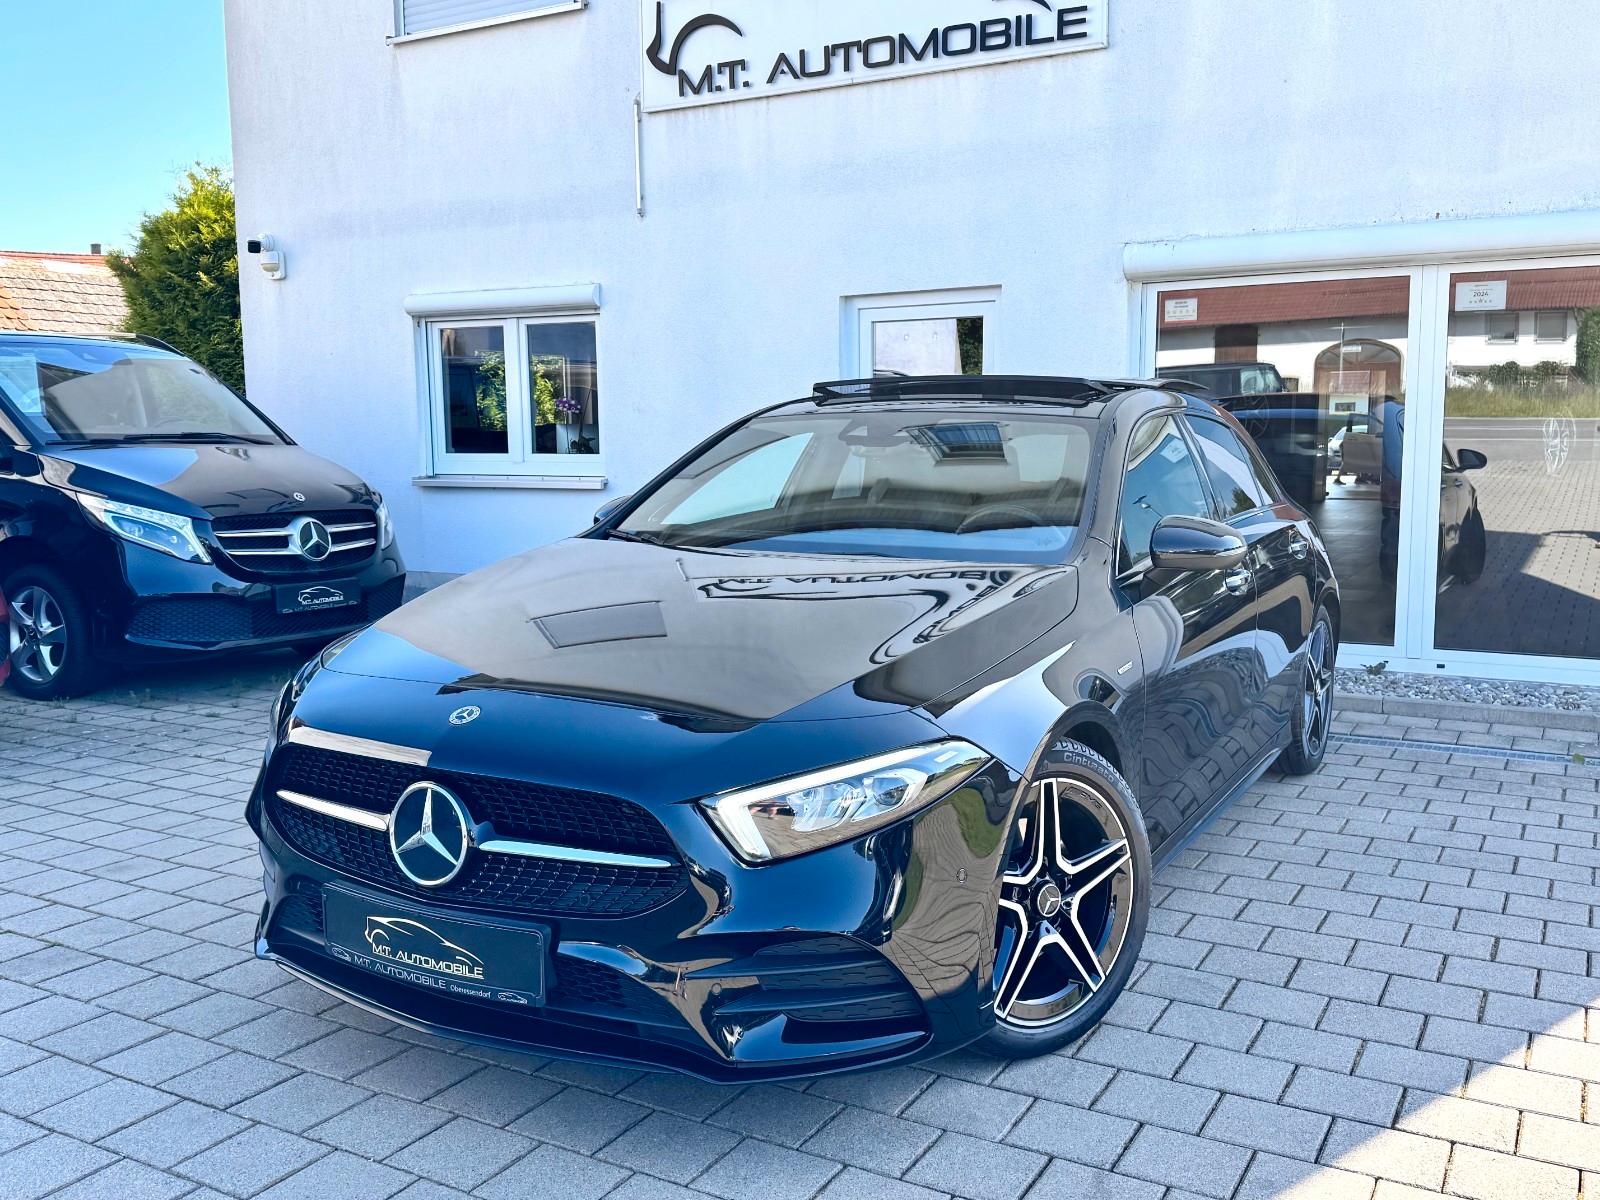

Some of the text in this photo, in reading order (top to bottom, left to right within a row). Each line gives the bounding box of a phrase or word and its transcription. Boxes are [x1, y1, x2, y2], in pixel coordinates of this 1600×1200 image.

[677, 4, 1089, 98] M.T. AUTOMOBILE
[354, 955, 447, 989] M.T. AUTOMOBILE
[372, 942, 484, 979] M.T. AUTOMOBILE
[449, 984, 491, 999] Oberessendorf
